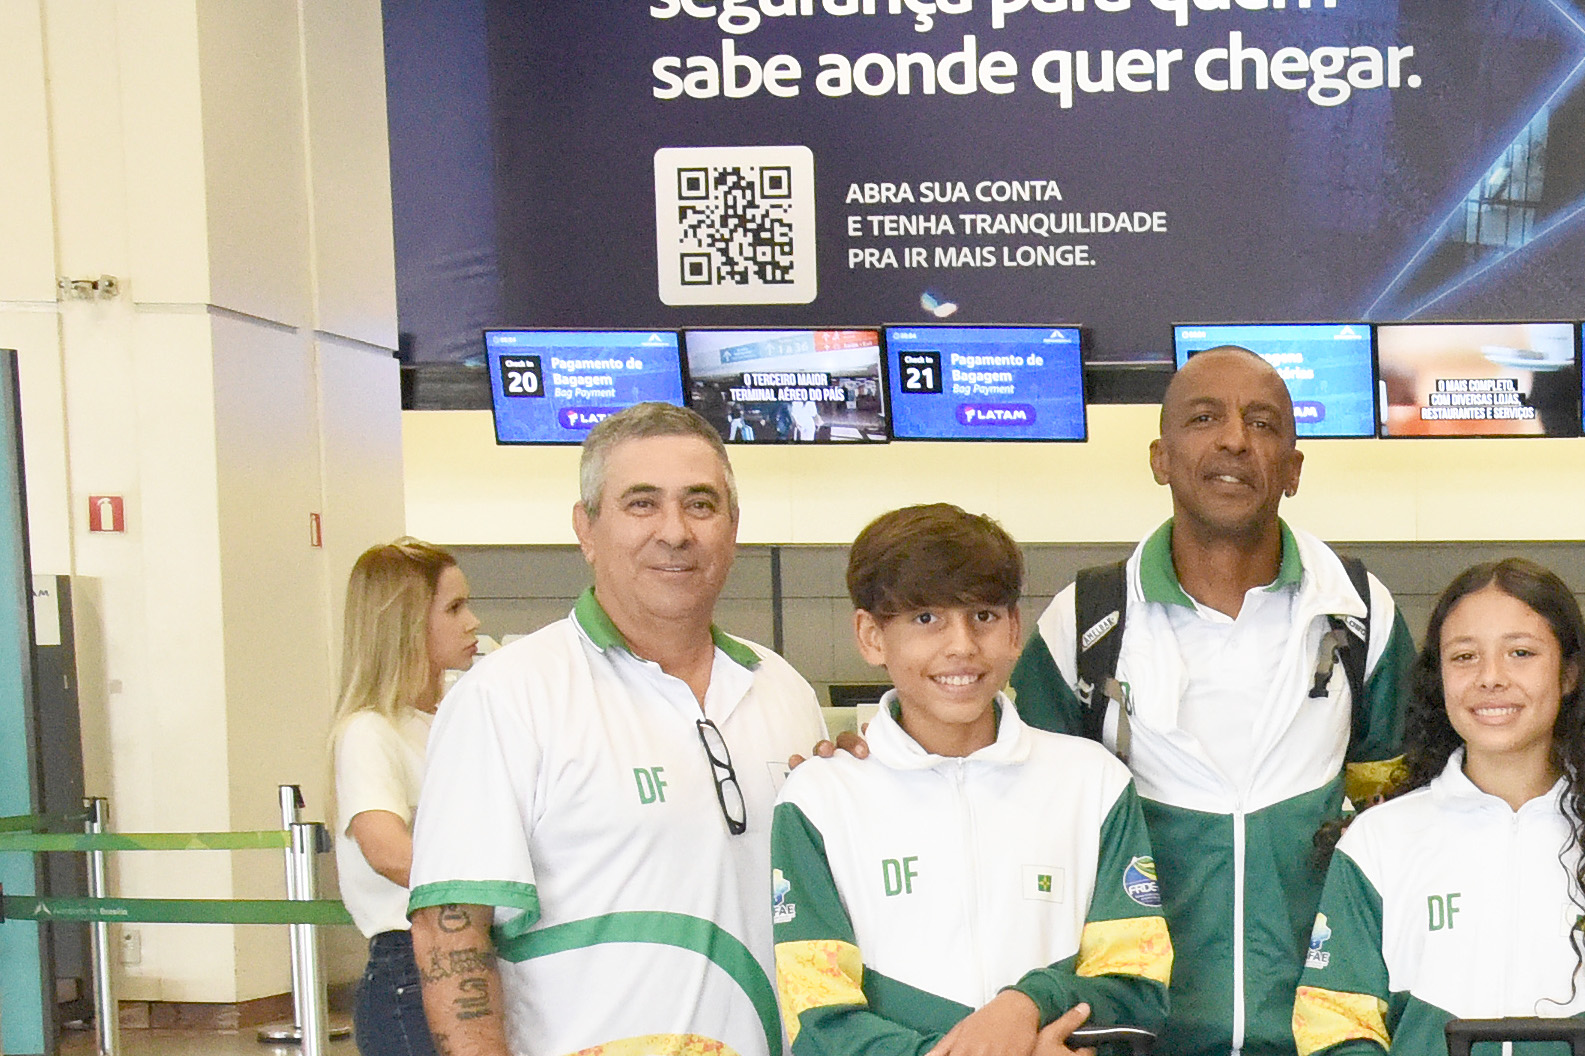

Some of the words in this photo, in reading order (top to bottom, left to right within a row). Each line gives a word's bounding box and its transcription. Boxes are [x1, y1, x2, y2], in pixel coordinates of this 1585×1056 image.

[650, 39, 801, 99] sabe
[815, 35, 1015, 97] aonde
[1032, 45, 1183, 108] quer
[1194, 31, 1422, 106] chegar.
[846, 182, 915, 203] ABRA
[920, 182, 970, 202] SUA
[975, 180, 1063, 201] CONTA
[847, 216, 862, 237] E
[867, 214, 955, 236] TENHA
[959, 211, 1167, 236] TRANQUILIDADE
[848, 248, 899, 269] PRA
[904, 247, 929, 268] IR
[934, 246, 997, 267] MAIS
[1003, 245, 1096, 267] LONGE.
[551, 357, 624, 372] Pagamento
[626, 357, 643, 370] de
[951, 353, 1024, 367] Pagamento
[1027, 353, 1044, 366] de
[508, 372, 538, 393] 20
[553, 373, 613, 388] Bagagem
[743, 374, 751, 386] O
[752, 373, 796, 386] TERCEIRO
[799, 373, 828, 386] MAIOR
[906, 367, 934, 389] 21
[952, 370, 1013, 383] Bagagem
[953, 384, 971, 396] Bag
[973, 384, 1015, 396] Payment
[1445, 380, 1467, 391] MAIS
[555, 388, 574, 399] Bag
[575, 388, 616, 399] Payment
[729, 388, 777, 402] TERMINAL
[778, 387, 808, 401] AÉREO
[809, 388, 823, 401] DO
[824, 386, 845, 401] PAÍS
[1431, 394, 1452, 406] COM
[1452, 394, 1492, 405] DIVERSAS
[977, 410, 1027, 420] LATAM
[1421, 407, 1485, 420] RESTAURANTES
[1494, 407, 1535, 420] SERVIÇOS
[633, 767, 667, 804] DF
[882, 856, 919, 898] DF
[1427, 892, 1462, 932] DF
